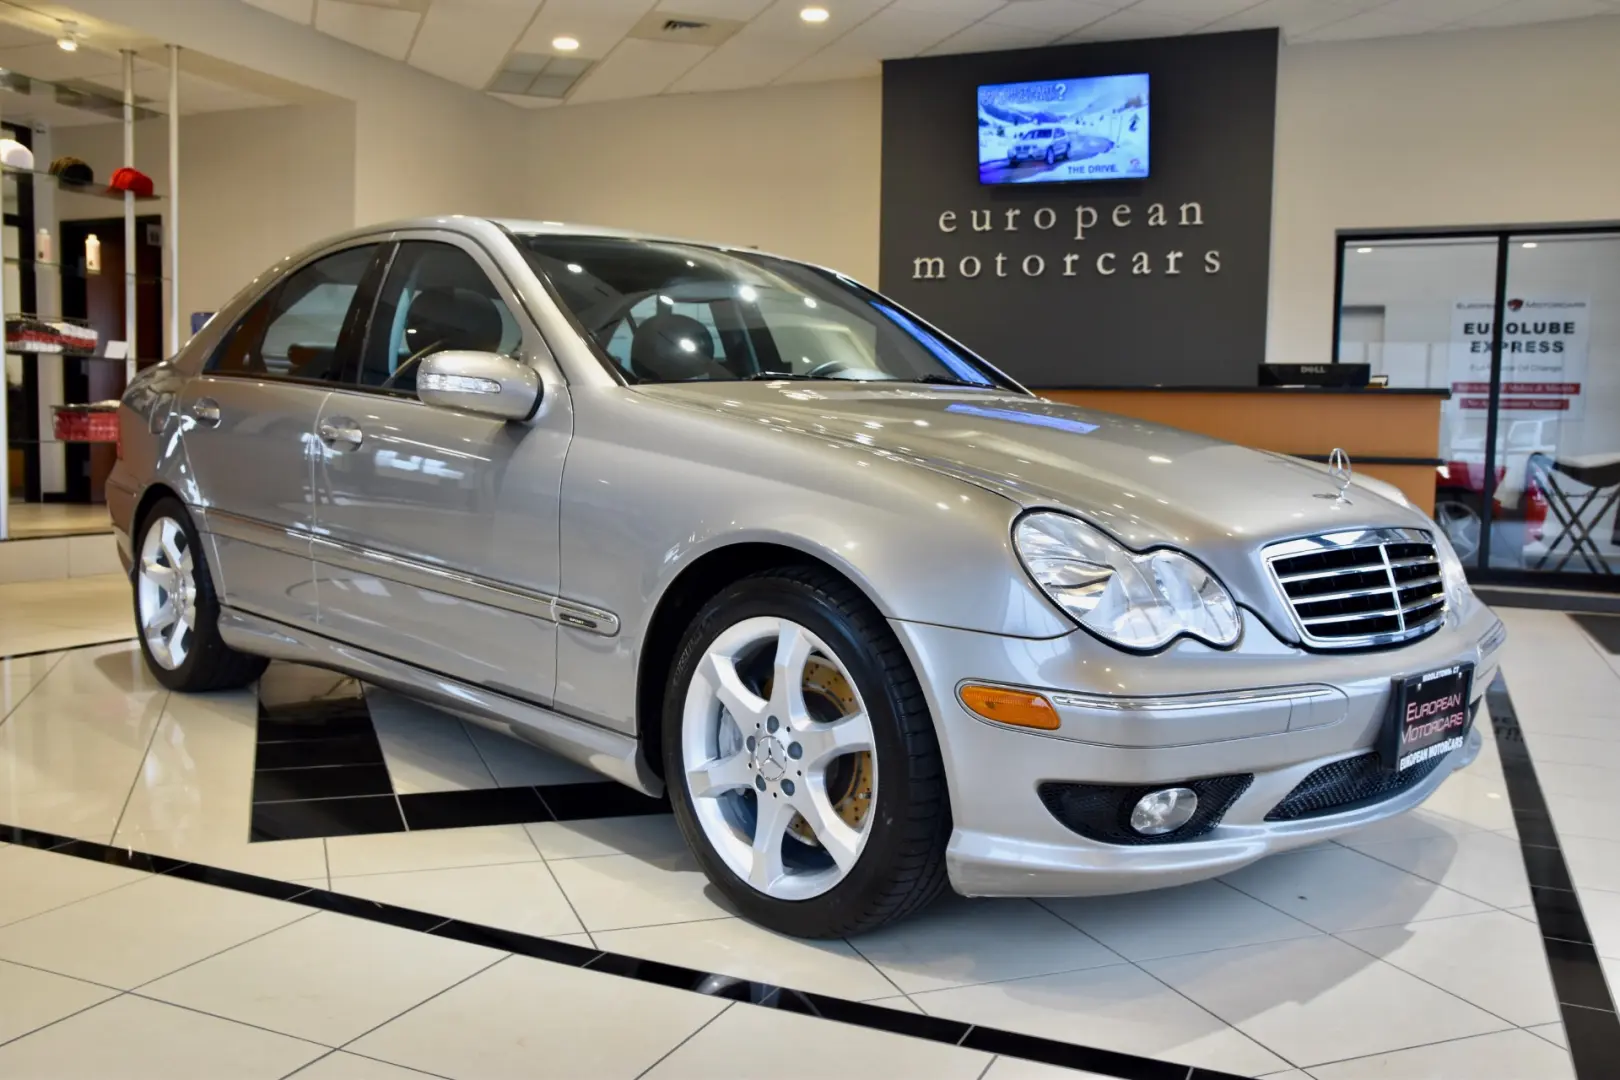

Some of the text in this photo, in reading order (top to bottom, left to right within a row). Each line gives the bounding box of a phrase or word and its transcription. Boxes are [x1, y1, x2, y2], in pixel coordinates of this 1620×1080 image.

[1067, 165, 1085, 174] THE
[938, 200, 1204, 241] european
[912, 249, 1221, 279] motorcars
[1464, 322, 1575, 335] EUOLUBE
[1300, 365, 1326, 374] DELL
[1452, 665, 1460, 674] CT
[1406, 694, 1461, 722] EUROPEAN
[1402, 712, 1463, 744] MOTORCARS
[1400, 736, 1463, 771] EUROPEAN MOTORCARS
